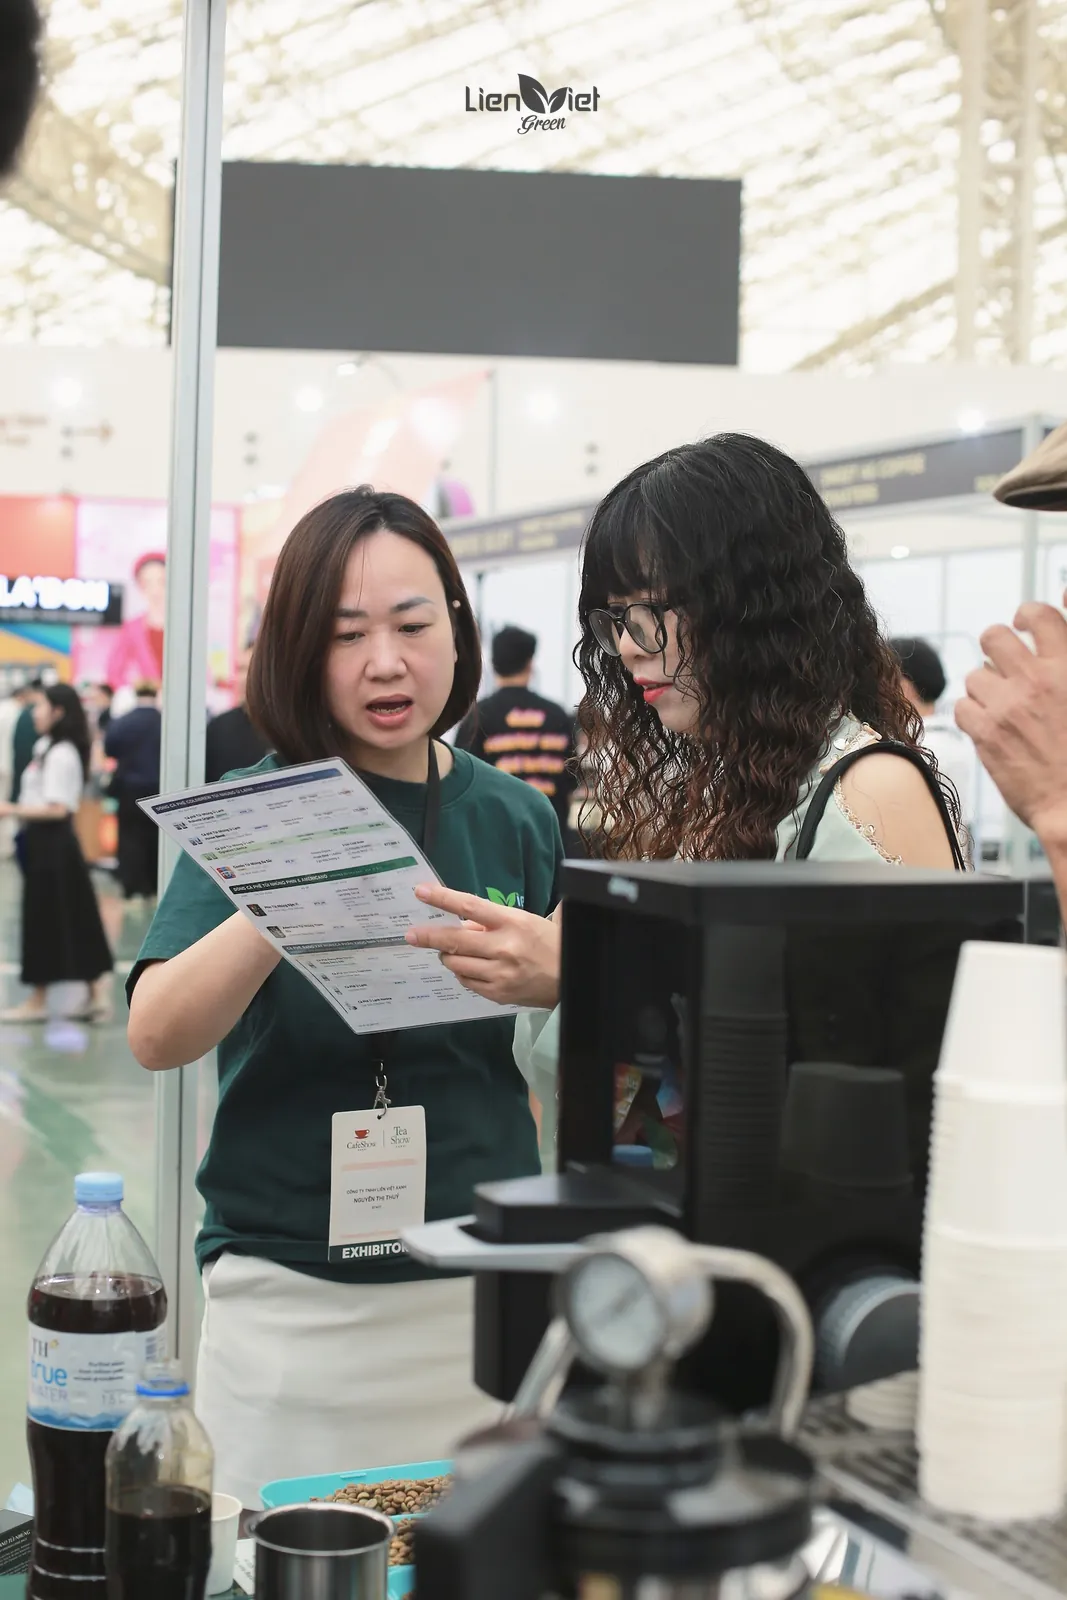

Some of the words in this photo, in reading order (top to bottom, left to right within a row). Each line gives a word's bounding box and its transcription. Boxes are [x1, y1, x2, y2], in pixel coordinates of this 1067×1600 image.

[394, 1126, 407, 1135] Tea
[346, 1141, 376, 1149] CafeShow
[391, 1136, 410, 1145] Show
